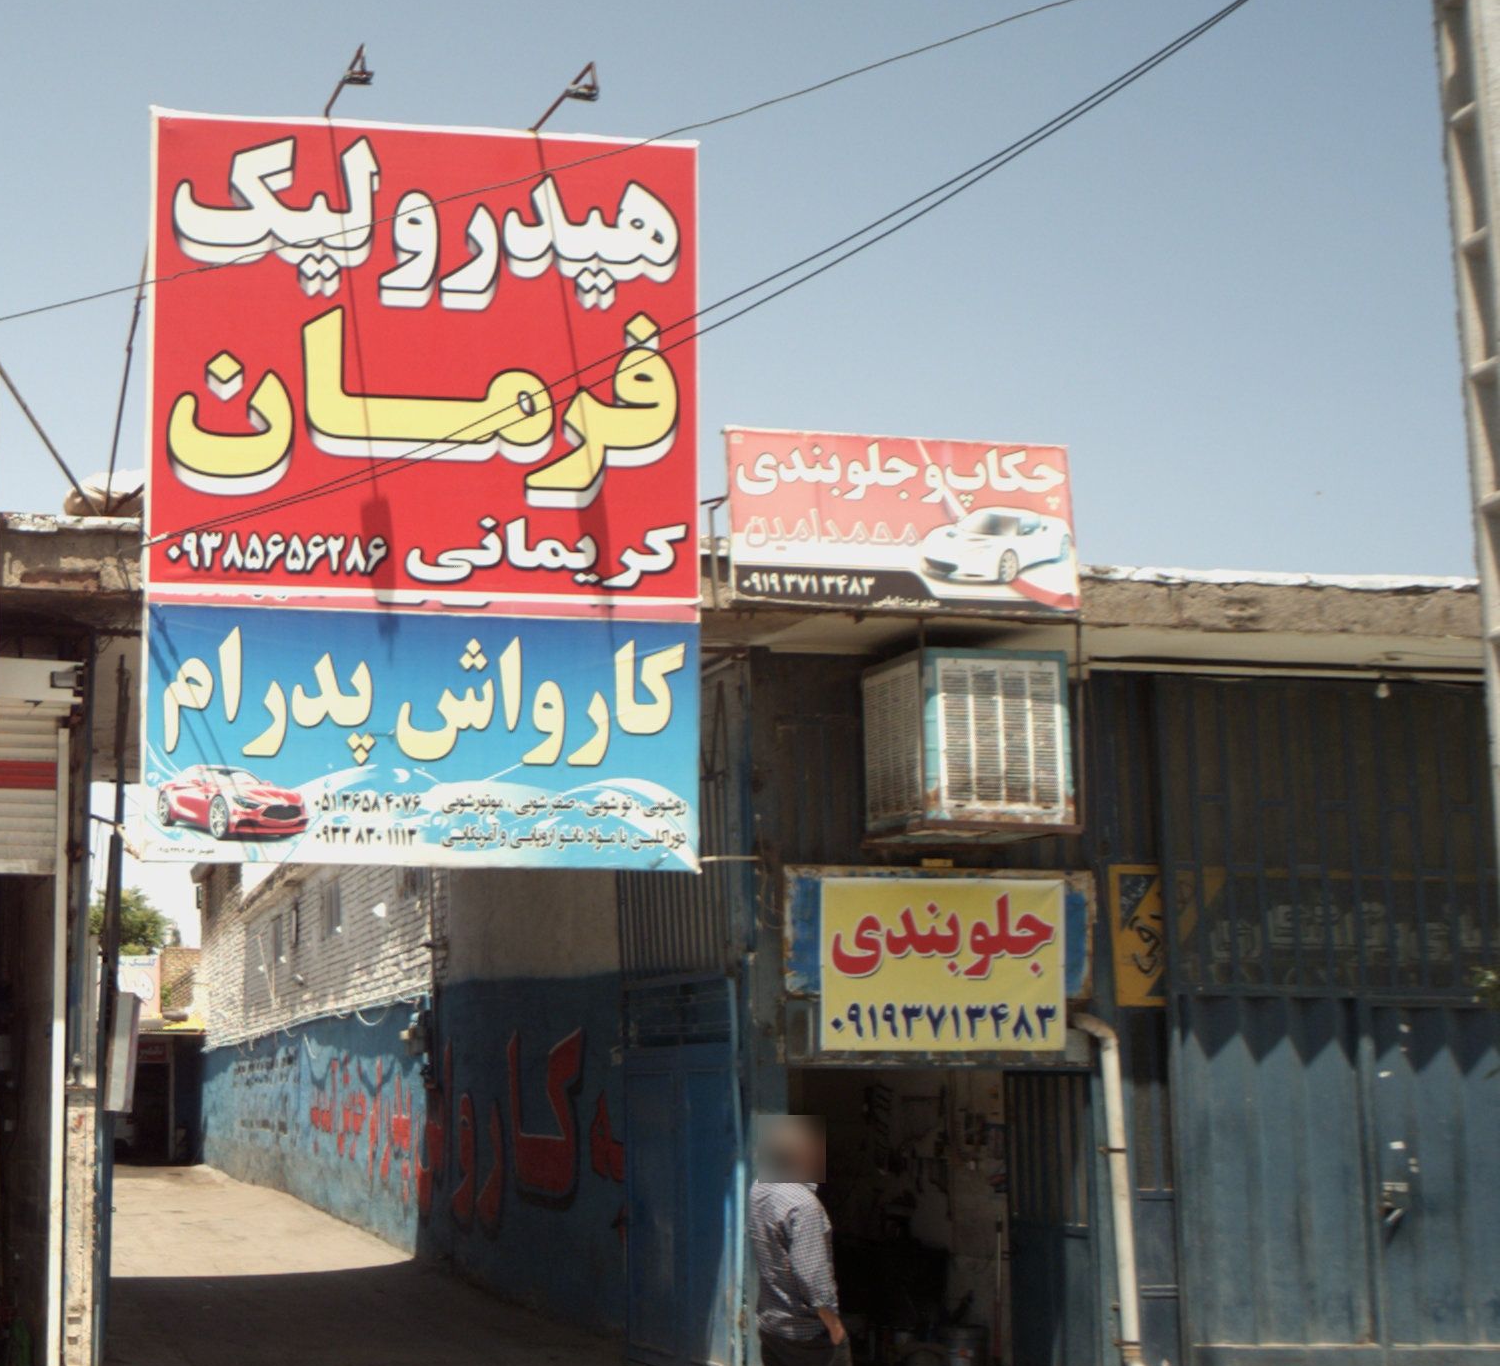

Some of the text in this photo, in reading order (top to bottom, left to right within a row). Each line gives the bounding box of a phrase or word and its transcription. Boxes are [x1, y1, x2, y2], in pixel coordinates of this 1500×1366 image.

[171, 134, 683, 312] هیدرولیک
[167, 303, 683, 509] فرمان
[735, 440, 920, 502] جلوبندی
[945, 446, 1067, 509] چکاپ
[166, 515, 689, 591] کریمانی ۰۹۳۸۵۶۵۶۲۸۶
[160, 625, 688, 767] کارواش پدرام
[831, 892, 1056, 979] جلوبندی
[830, 1002, 1057, 1039] ۰۹۱۹۳۷۱۳۴۸۳
